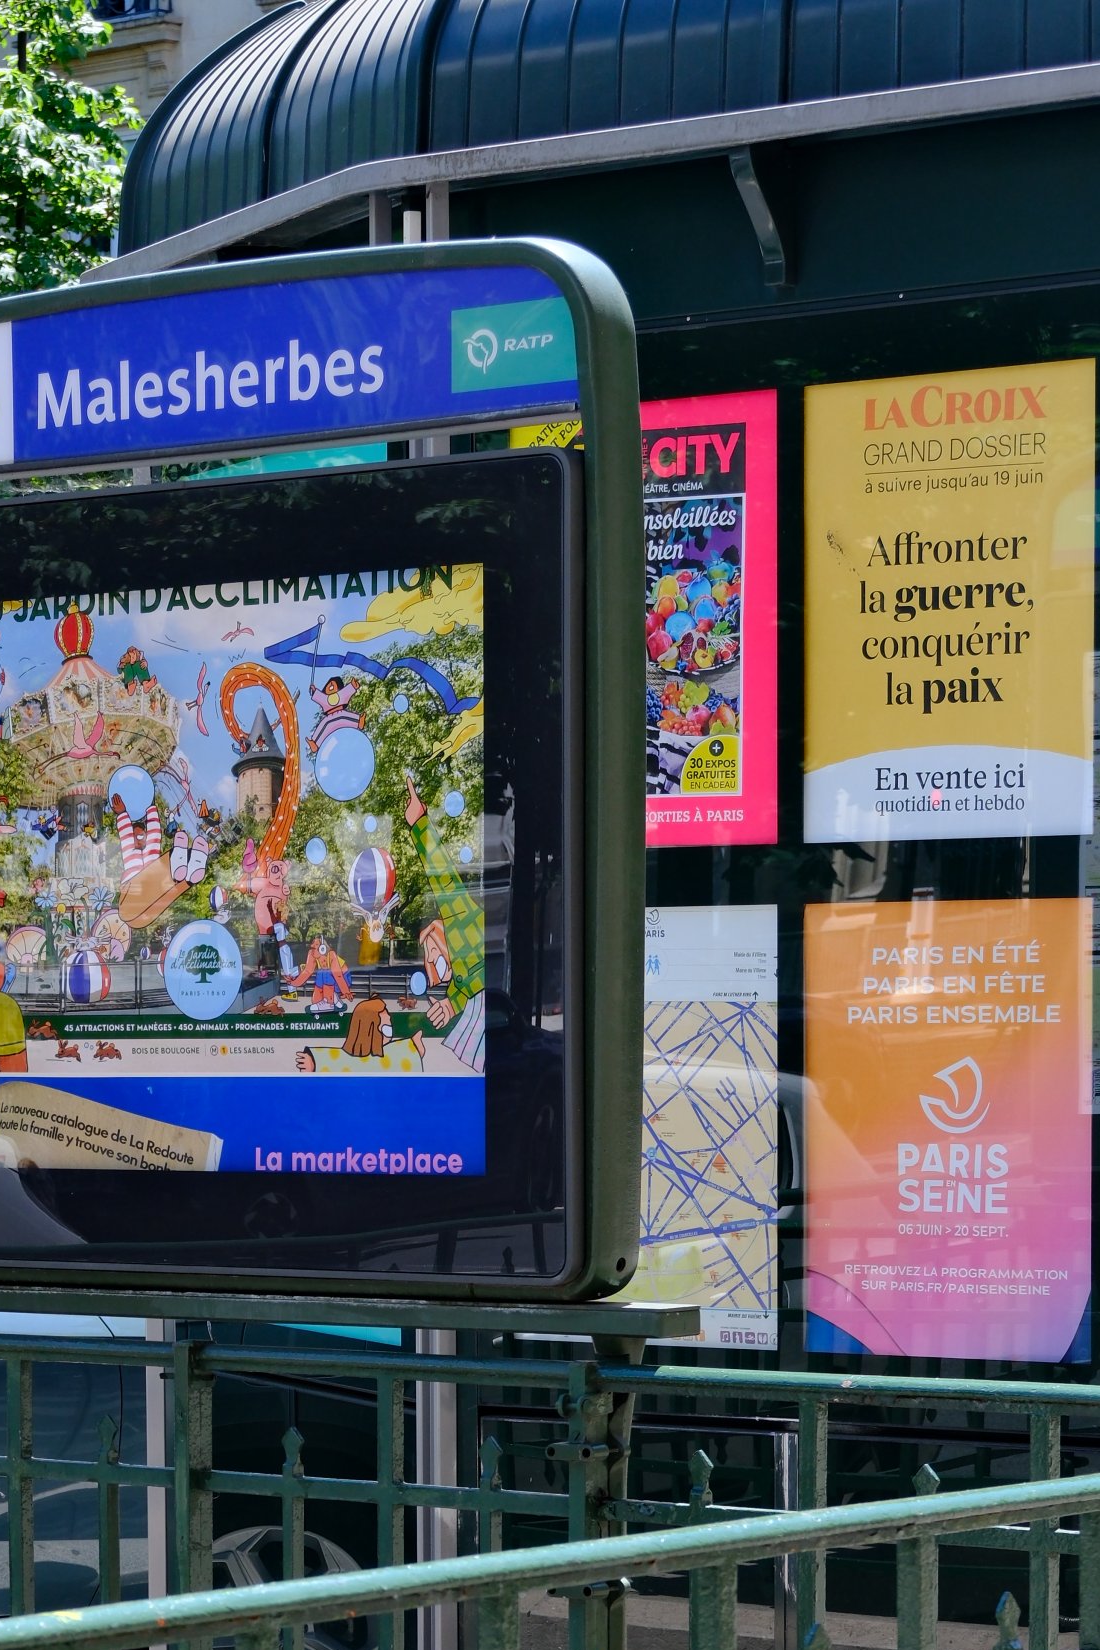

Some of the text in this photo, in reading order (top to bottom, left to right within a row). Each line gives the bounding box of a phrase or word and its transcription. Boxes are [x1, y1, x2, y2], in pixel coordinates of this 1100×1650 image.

[504, 334, 554, 352] RATP
[37, 339, 385, 430] Malesherbes
[650, 432, 741, 478] CITY
[864, 432, 1046, 466] GRAND DOSSIER
[644, 481, 704, 494] ÉÂTRE, CINÉMA
[865, 468, 1043, 494] à suivre jusqu'au 19 juin
[644, 506, 737, 530] nsoleillées
[647, 540, 684, 561] bien
[867, 530, 1028, 567] Affronter
[13, 591, 130, 623] JARDIN
[860, 580, 1034, 622] la guerre,
[862, 621, 1030, 666] conquérir
[886, 666, 1004, 714] la paix
[686, 770, 736, 779] GRATUITES
[690, 758, 736, 769] 30 EXPOS
[690, 780, 736, 789] EN CADEAU
[875, 763, 1026, 791] En vente ici
[694, 806, 703, 822] À
[707, 809, 744, 822] PARIS
[875, 794, 1025, 816] quotidien et hebdo
[644, 929, 665, 938] ARIS
[188, 947, 218, 961] Jardin
[871, 939, 1040, 966] PARIS EN ÉTÉ
[863, 970, 1045, 995] PARIS EN FÊTE
[847, 1004, 1061, 1024] PARIS ENSEMBLE
[64, 1024, 74, 1032] 45
[75, 1024, 125, 1032] ATTRACTIONS
[126, 1024, 135, 1032] ET
[136, 1022, 173, 1032] MANÈGES
[195, 1023, 229, 1031] ANIMAUX
[235, 1023, 285, 1031] PROMENADES
[290, 1022, 340, 1031] RESTAURANTS
[131, 1047, 149, 1055] BOIS
[150, 1047, 160, 1055] DE
[161, 1047, 200, 1055] BOULOGNE
[229, 1047, 242, 1055] LES
[243, 1047, 275, 1055] SABLONS
[0, 1102, 194, 1165] Le nouveau catalogue de La Redoute
[0, 1119, 170, 1172] toute la famille y trouve son bonh
[255, 1147, 463, 1174] La marketplace
[897, 1142, 1009, 1179] PARIS
[898, 1223, 914, 1236] 06
[915, 1223, 942, 1236] JUIN
[954, 1224, 969, 1237] 20
[972, 1225, 1009, 1238] SEPT.
[845, 1264, 1068, 1281] RETROUVEZ LA PROGRAMMATION
[861, 1280, 1051, 1296] SUR PARIS.FR/PARISENSEINE
